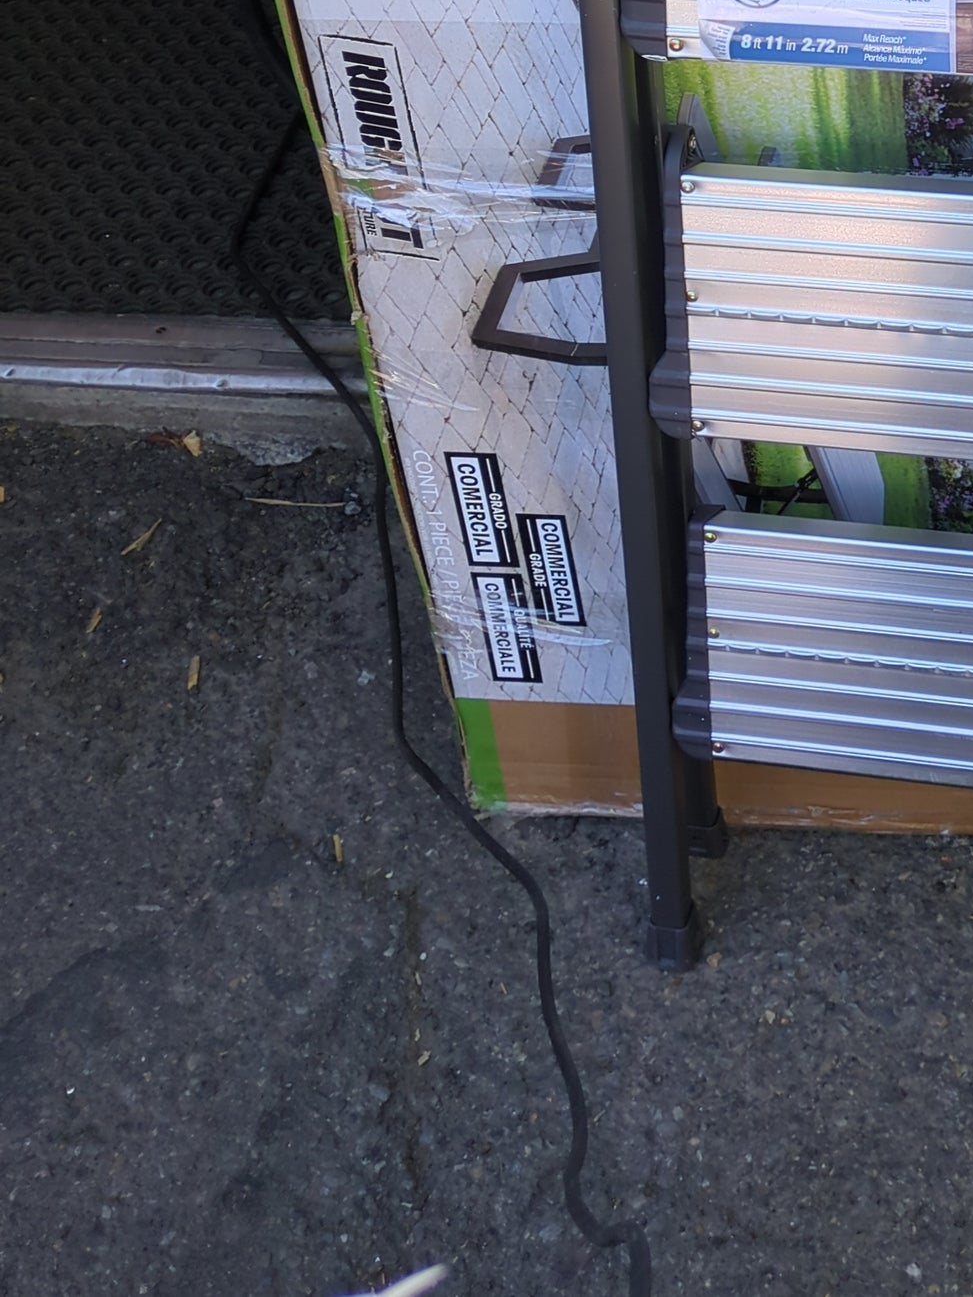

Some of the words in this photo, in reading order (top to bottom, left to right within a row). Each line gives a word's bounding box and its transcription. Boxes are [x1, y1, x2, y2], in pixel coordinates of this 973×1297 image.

[741, 34, 751, 49] 8
[752, 37, 762, 50] ft
[766, 36, 783, 51] 11
[785, 38, 796, 51] in
[800, 37, 836, 53] 2.72
[836, 43, 848, 55] m
[863, 33, 879, 43] Max
[457, 464, 493, 556] COMERCIAL
[489, 493, 507, 528] GRADO
[428, 523, 455, 566] PIECE
[529, 554, 546, 586] GRADE
[541, 523, 571, 617] COMMERCIAL
[485, 583, 516, 673] COMMERCIALE
[513, 609, 534, 649] QUALITÉ
